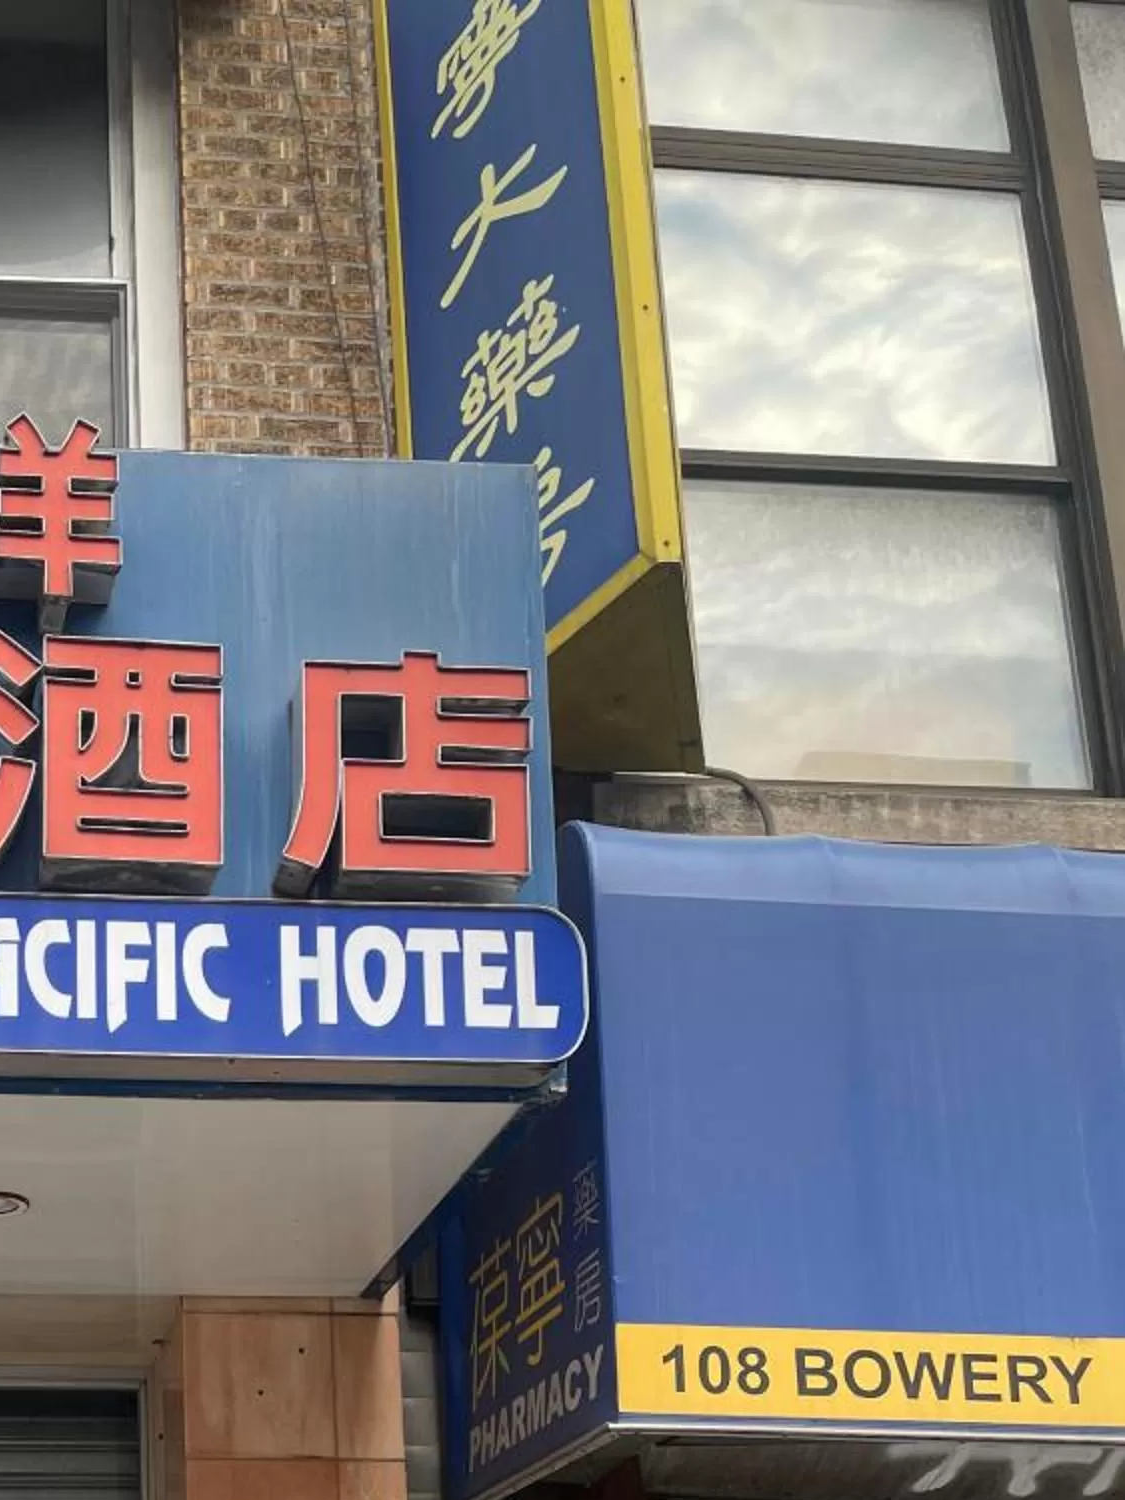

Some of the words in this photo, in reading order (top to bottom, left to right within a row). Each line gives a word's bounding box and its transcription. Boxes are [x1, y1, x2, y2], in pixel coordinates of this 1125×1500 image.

[283, 924, 560, 1037] HOTEL
[467, 1344, 605, 1473] PHARMACY
[662, 1343, 770, 1396] 108
[794, 1347, 1094, 1406] BOWERY
